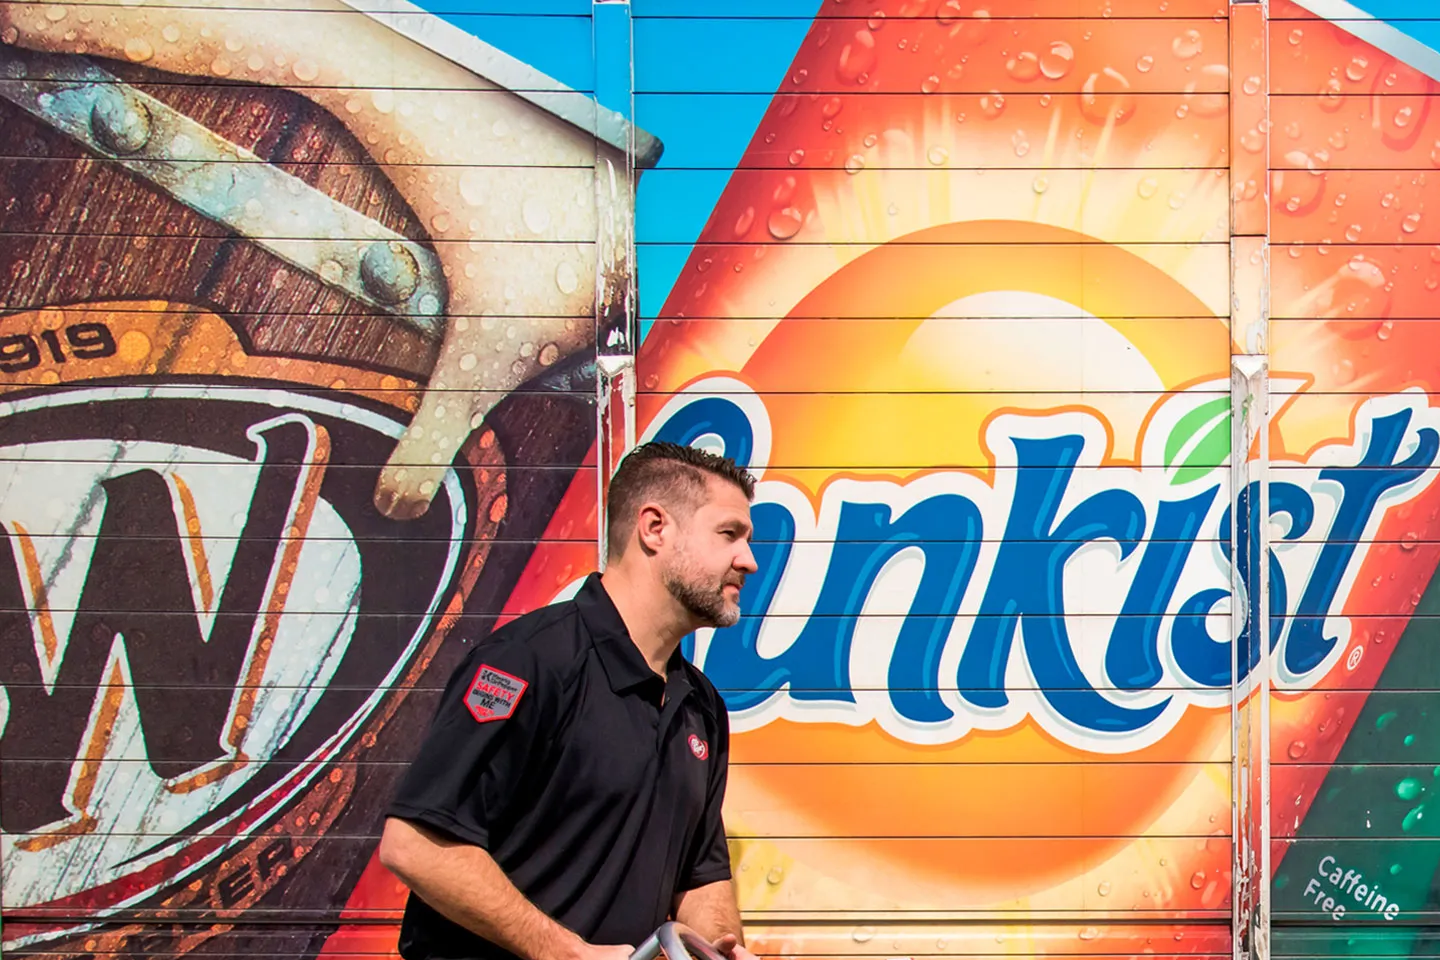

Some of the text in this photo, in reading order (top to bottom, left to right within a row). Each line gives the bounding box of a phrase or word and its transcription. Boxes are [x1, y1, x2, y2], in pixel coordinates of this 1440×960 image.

[476, 681, 515, 701] SAFETY
[480, 698, 495, 709] ME
[1304, 879, 1346, 920] Free
[1319, 856, 1400, 920] Caffeine
